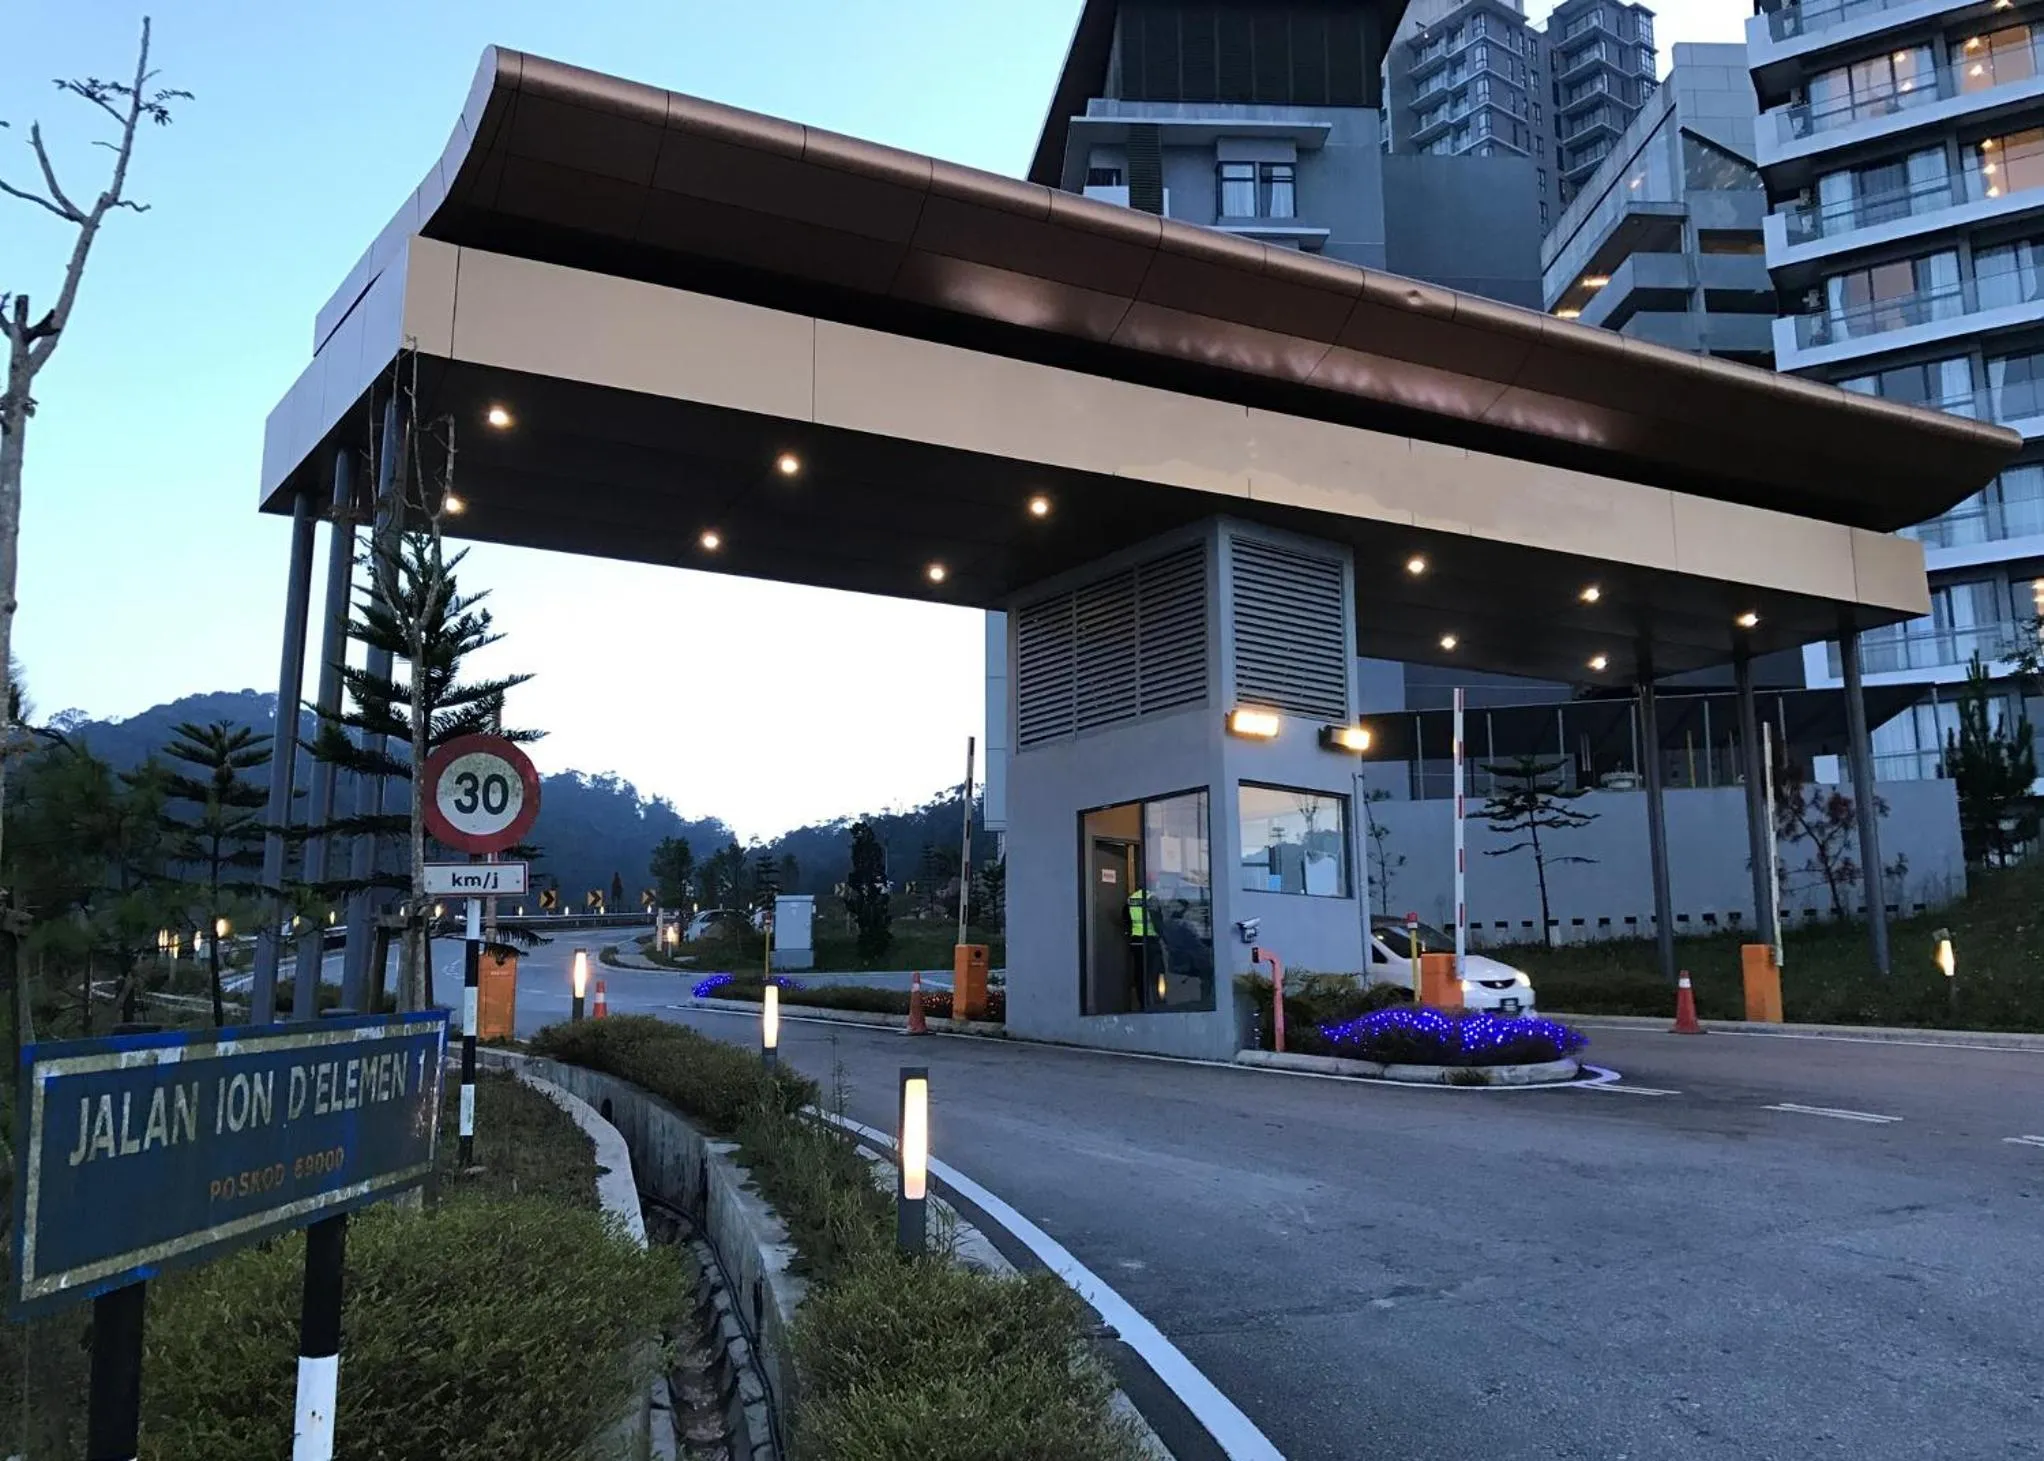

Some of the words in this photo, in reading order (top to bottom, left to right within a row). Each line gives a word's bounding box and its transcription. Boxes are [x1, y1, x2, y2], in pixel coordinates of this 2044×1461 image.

[454, 772, 509, 815] 30
[452, 872, 499, 889] km/j
[69, 1082, 198, 1166] JALAN
[215, 1070, 274, 1135] ION
[287, 1051, 407, 1121] D'ELEMEN
[416, 1049, 426, 1093] 1
[209, 1162, 286, 1202] POSKOD
